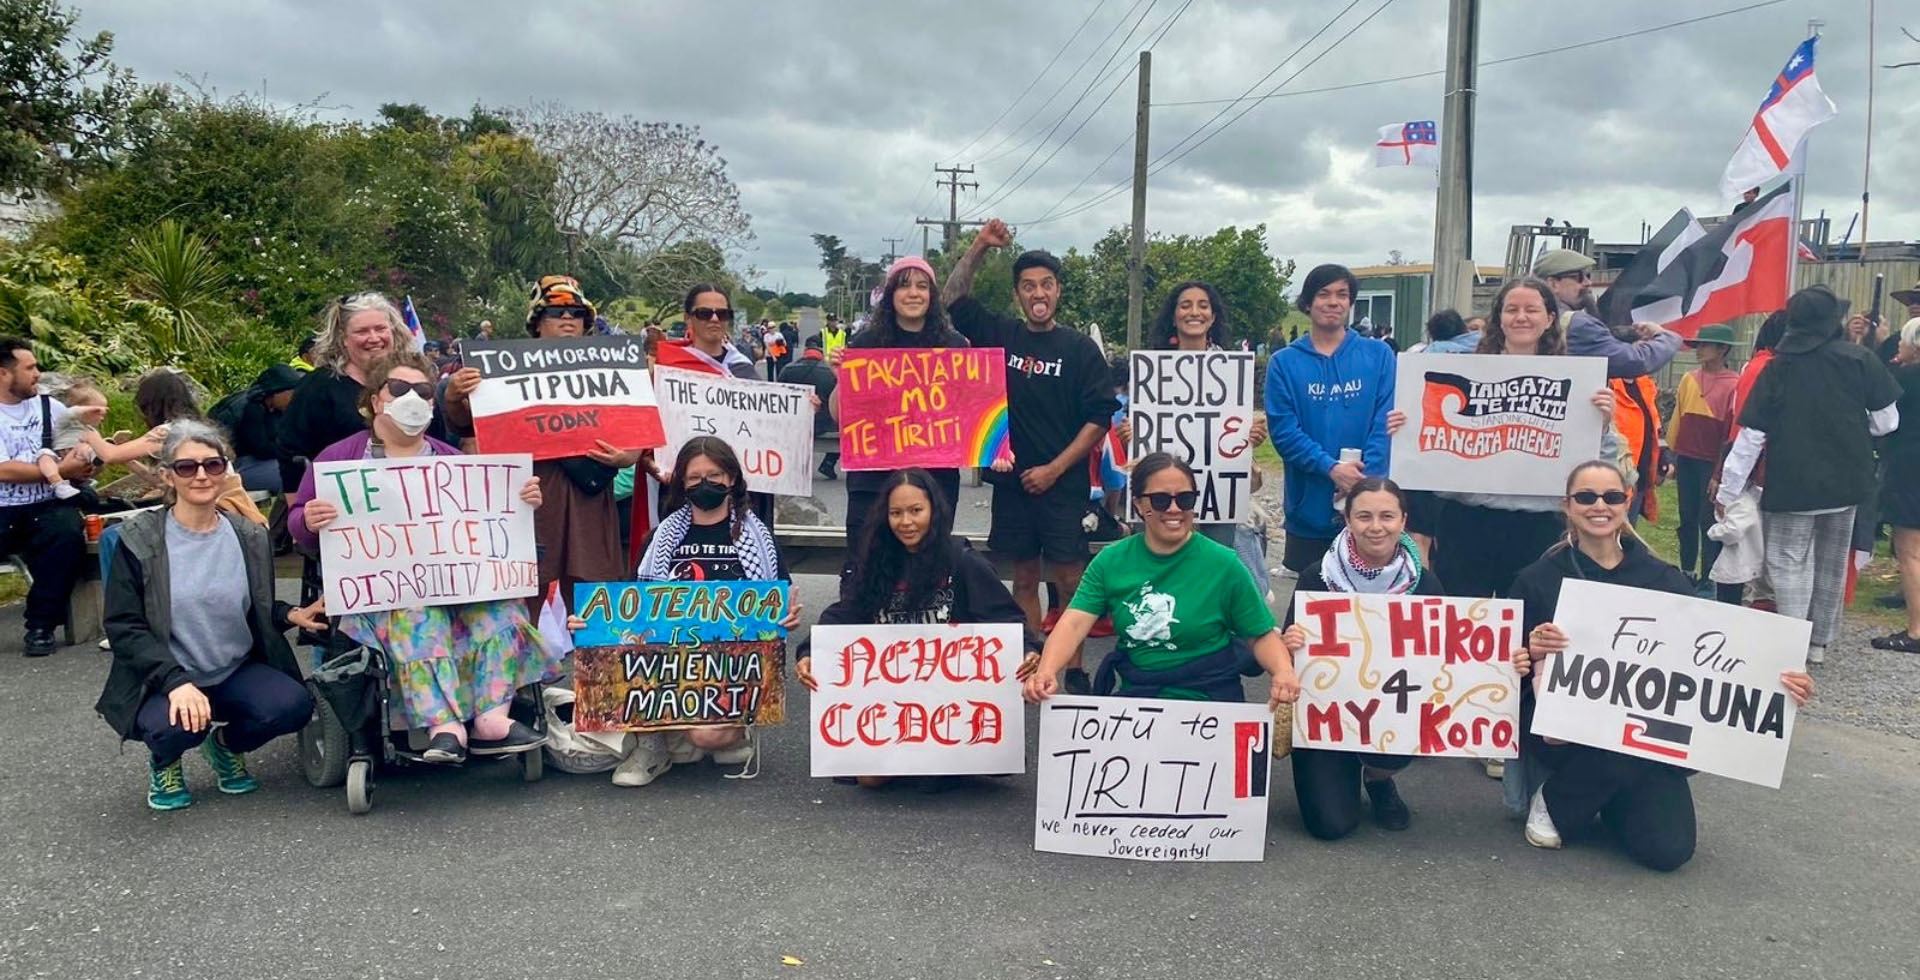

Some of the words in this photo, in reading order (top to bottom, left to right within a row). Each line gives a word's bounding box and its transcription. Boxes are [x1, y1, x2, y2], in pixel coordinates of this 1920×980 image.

[505, 370, 630, 401] TIPUNA
[665, 379, 698, 404] THE
[705, 386, 802, 415] GOVERNMENT
[901, 381, 947, 412] MŌ
[1133, 353, 1253, 406] RESIST
[1469, 377, 1562, 397] TANGATA
[525, 410, 599, 433] TODAY
[1469, 399, 1503, 416] TE
[1508, 395, 1566, 420] TIRITI
[1471, 413, 1526, 428] STANDING
[691, 415, 717, 435] IS
[737, 421, 752, 438] A
[844, 419, 878, 456] TE
[1133, 411, 1221, 466] REST
[1422, 426, 1501, 456] TANGATA
[322, 468, 381, 515] TE
[385, 461, 522, 520] TIRITI
[328, 520, 481, 560] JUSTICE
[483, 518, 509, 559] IS
[702, 545, 716, 554] TE
[339, 562, 481, 609] DISABILITY
[581, 585, 784, 623] AOTEAROA
[670, 626, 703, 649] IS
[1305, 598, 1351, 657] I
[1612, 616, 1666, 657] For
[1693, 630, 1747, 674] Our
[624, 653, 762, 682] WHENUA
[830, 636, 1006, 688] NEVER
[624, 683, 760, 725] MĀORI!
[1381, 668, 1421, 714] 4
[1547, 652, 1786, 739] MOKOPUNA
[820, 700, 1003, 747] CEDED
[1050, 705, 1164, 740] Toitū
[1181, 713, 1219, 739] te
[1307, 698, 1381, 745] MY
[1052, 749, 1218, 819] TIRITI
[1042, 820, 1060, 833] we
[1073, 822, 1118, 836] never
[1130, 824, 1194, 839] ceeded
[1209, 827, 1243, 839] our
